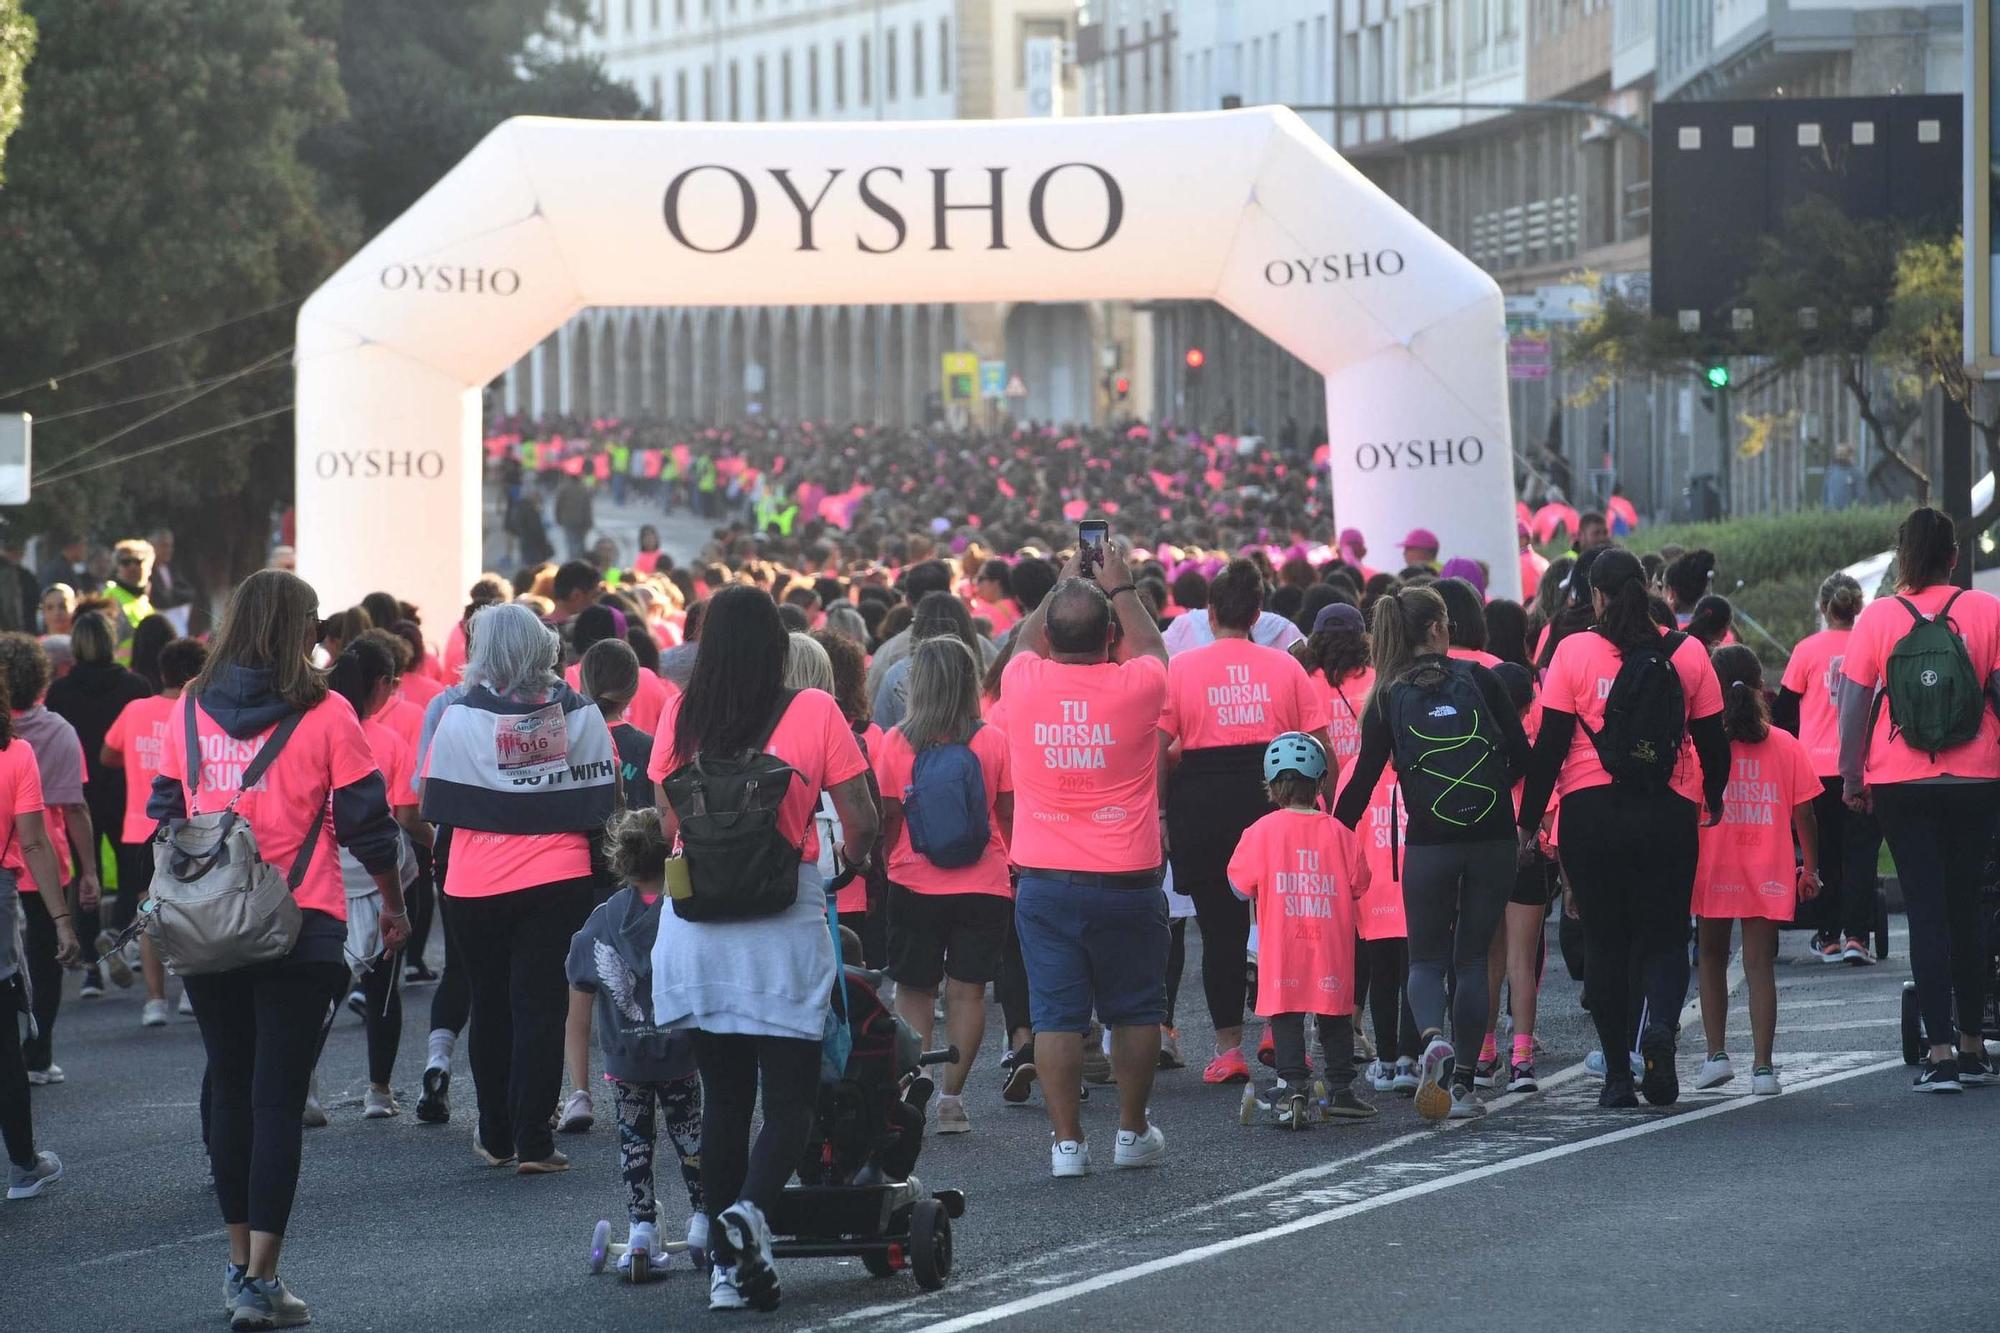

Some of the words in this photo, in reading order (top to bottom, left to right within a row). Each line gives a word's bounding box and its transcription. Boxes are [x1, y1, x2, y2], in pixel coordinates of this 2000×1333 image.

[662, 163, 1125, 254] OYSHO
[1264, 251, 1405, 284] OYSHO
[380, 265, 521, 293] OYSHO
[315, 450, 445, 479] OYSHO
[1356, 437, 1485, 470] OYSHO
[1226, 664, 1250, 684] TU
[1208, 684, 1271, 706] DORSAL
[1060, 701, 1087, 722] TU
[1218, 705, 1265, 726] SUMA
[1034, 723, 1116, 746] DORSAL
[199, 734, 265, 762] DORSA
[1044, 747, 1107, 769] SUMA
[570, 760, 613, 781] WITH
[1737, 759, 1760, 779] TU
[1724, 803, 1774, 824] SUMA
[472, 834, 506, 844] OYSHO
[1296, 849, 1319, 871] TU
[1276, 872, 1337, 896] DORSAL
[1285, 896, 1332, 918] SUMA
